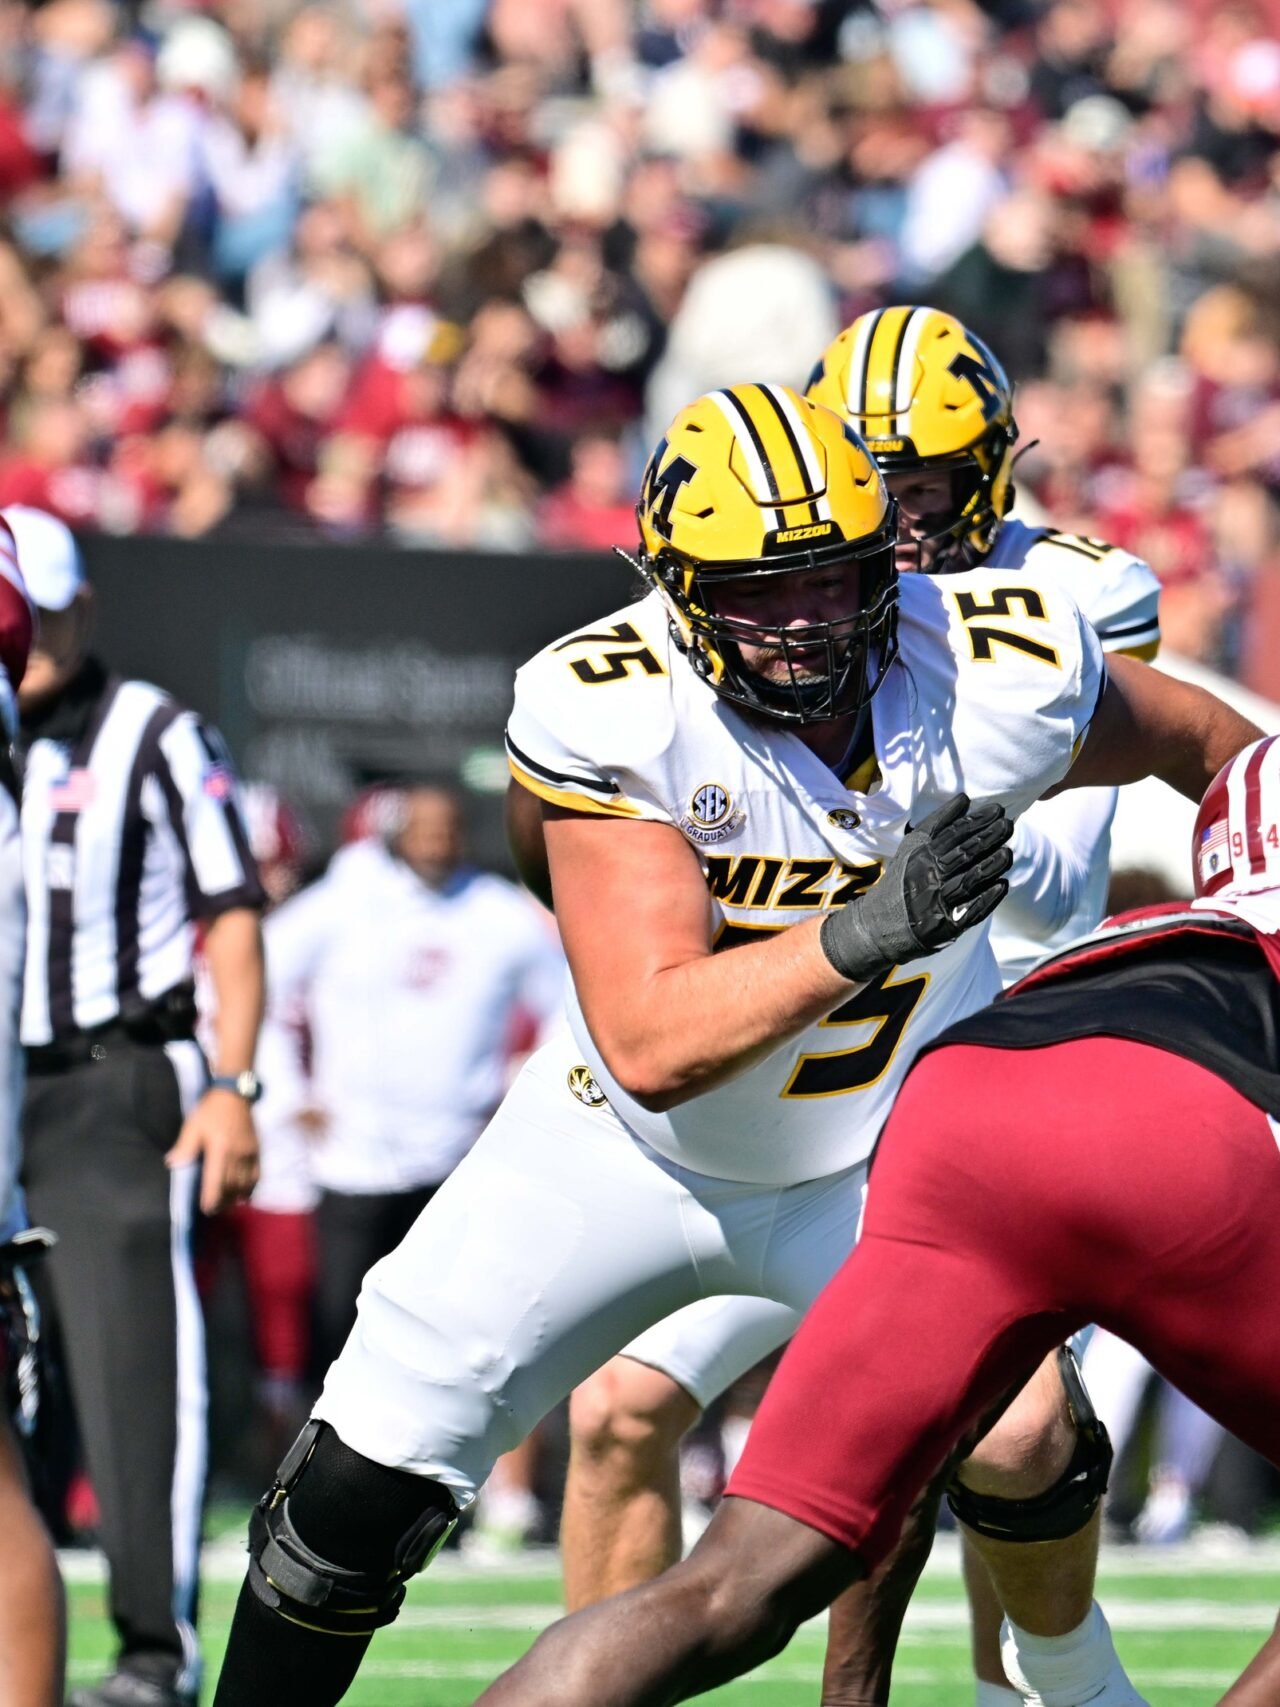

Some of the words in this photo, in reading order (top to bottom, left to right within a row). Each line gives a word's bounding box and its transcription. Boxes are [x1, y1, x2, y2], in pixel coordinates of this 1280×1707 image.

[776, 523, 832, 543] MIZZOU
[954, 586, 1062, 671] 75
[549, 620, 672, 686] 75
[693, 785, 727, 822] SEC
[686, 822, 735, 842] GRADUATE
[704, 854, 886, 911] MIZZ
